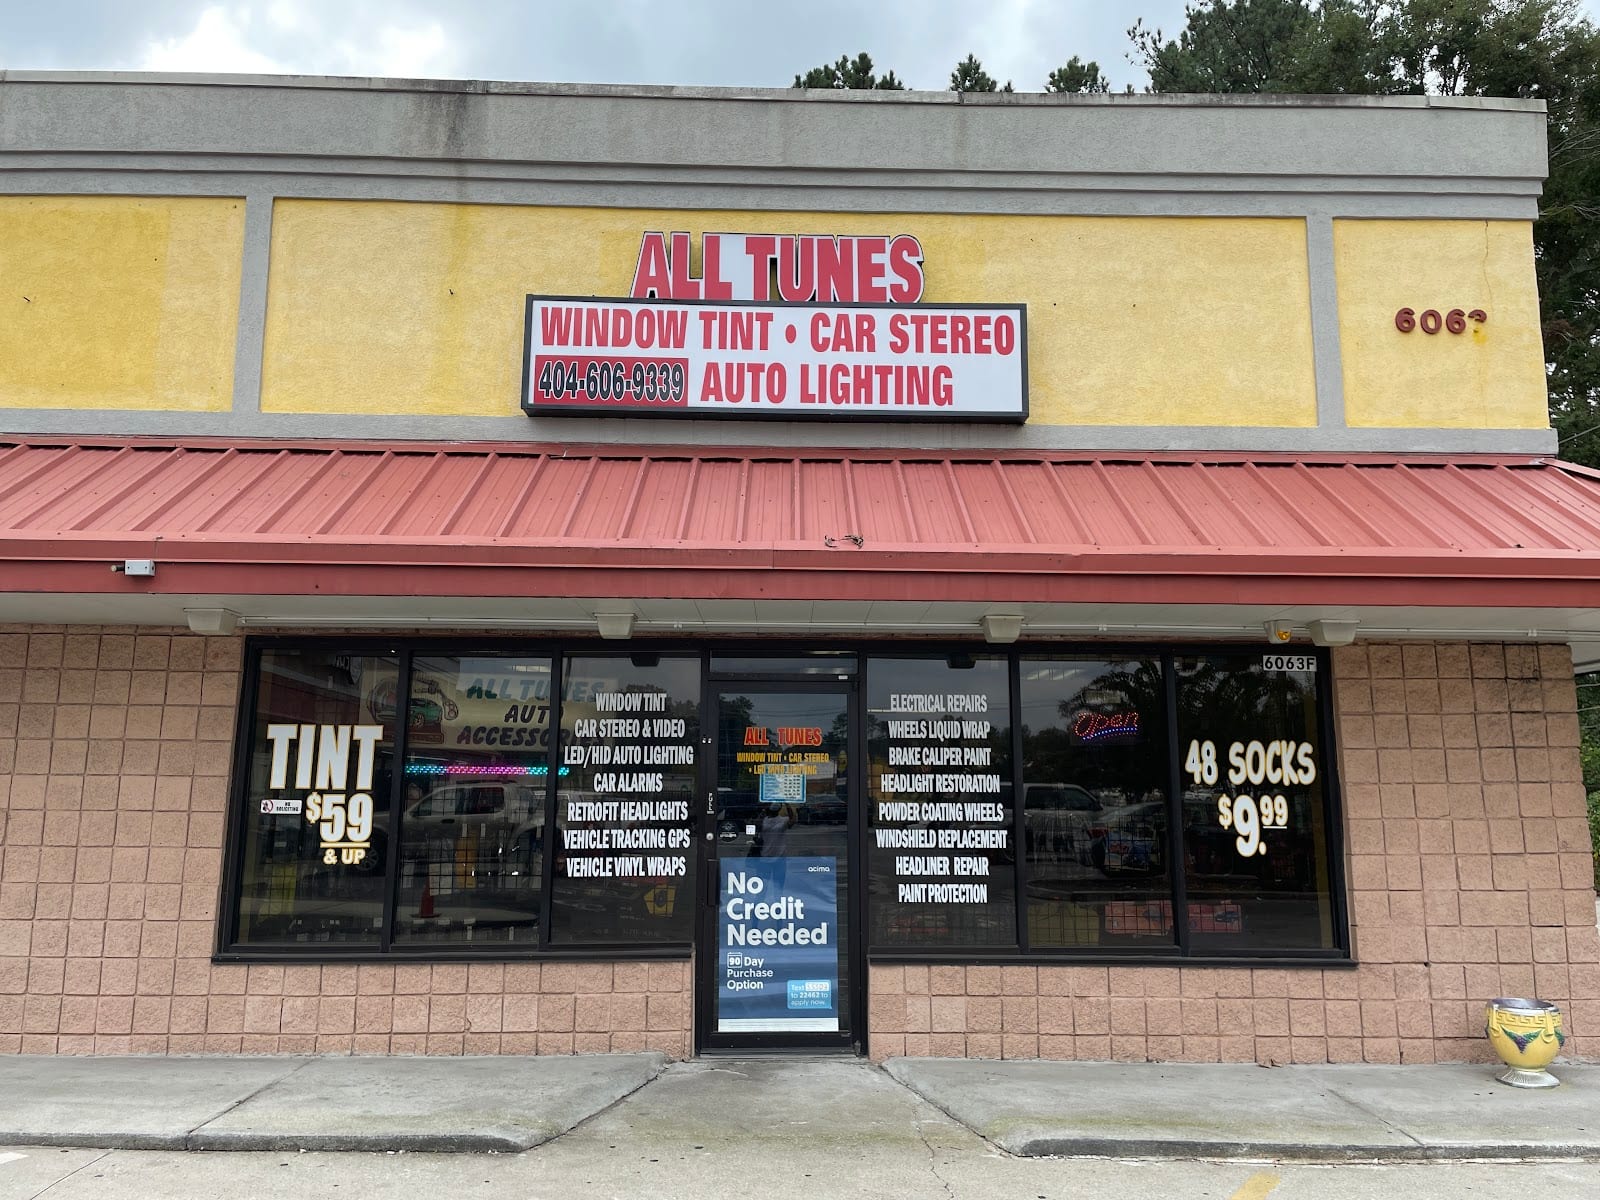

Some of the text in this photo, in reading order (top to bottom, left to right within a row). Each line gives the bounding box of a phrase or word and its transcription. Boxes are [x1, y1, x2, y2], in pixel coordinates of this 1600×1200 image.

[631, 233, 924, 303] ALL TUNES
[541, 307, 1014, 356] WINDOW TINT CAR STEREO
[539, 360, 685, 402] 404-606-9339
[700, 362, 954, 406] AUTO LIGHTING
[1264, 657, 1315, 670] 6063F
[595, 693, 667, 711] WINDOW TINT
[890, 694, 987, 712] ELECTRICAL REPAIRS
[504, 705, 564, 724] AUT
[1074, 712, 1138, 736] Open
[575, 719, 685, 738] CAR STEREO & VIDEO
[743, 727, 822, 746] ALL TUNES
[888, 721, 990, 742] WHEELS LIQUID WRAP
[267, 723, 384, 790] TINT
[564, 746, 694, 768] LED/HID AUTO LIGHTING
[736, 752, 829, 763] WINDOW TINT CAR STEREO
[889, 747, 991, 765] BRAKE CALIPER PAINT
[1185, 739, 1316, 786] 48 SOCKS
[594, 773, 663, 792] CAR ALARMS
[880, 774, 1000, 793] HEADLIGHT RESTORATION
[305, 792, 373, 842] $59
[567, 802, 619, 821] RETROFIT
[620, 801, 688, 821] HEADLIGHTS
[879, 802, 1004, 821] POWDER COATING WHEELS
[564, 829, 691, 849] VEHICLE TRACKING GPS
[875, 829, 1007, 848] WINDSHIELD REPLACEMENT
[323, 849, 366, 864] & UP
[895, 856, 989, 875] HEADLINER REPAIR
[566, 856, 686, 877] VEHICLE VINYL WRAPS
[727, 872, 764, 894] No
[898, 883, 987, 903] PAINT PROTECTION
[726, 896, 804, 920] Credit
[727, 922, 828, 946] Needed
[729, 956, 764, 967] 90 Day
[727, 968, 773, 978] Purchase
[727, 979, 764, 992] Option
